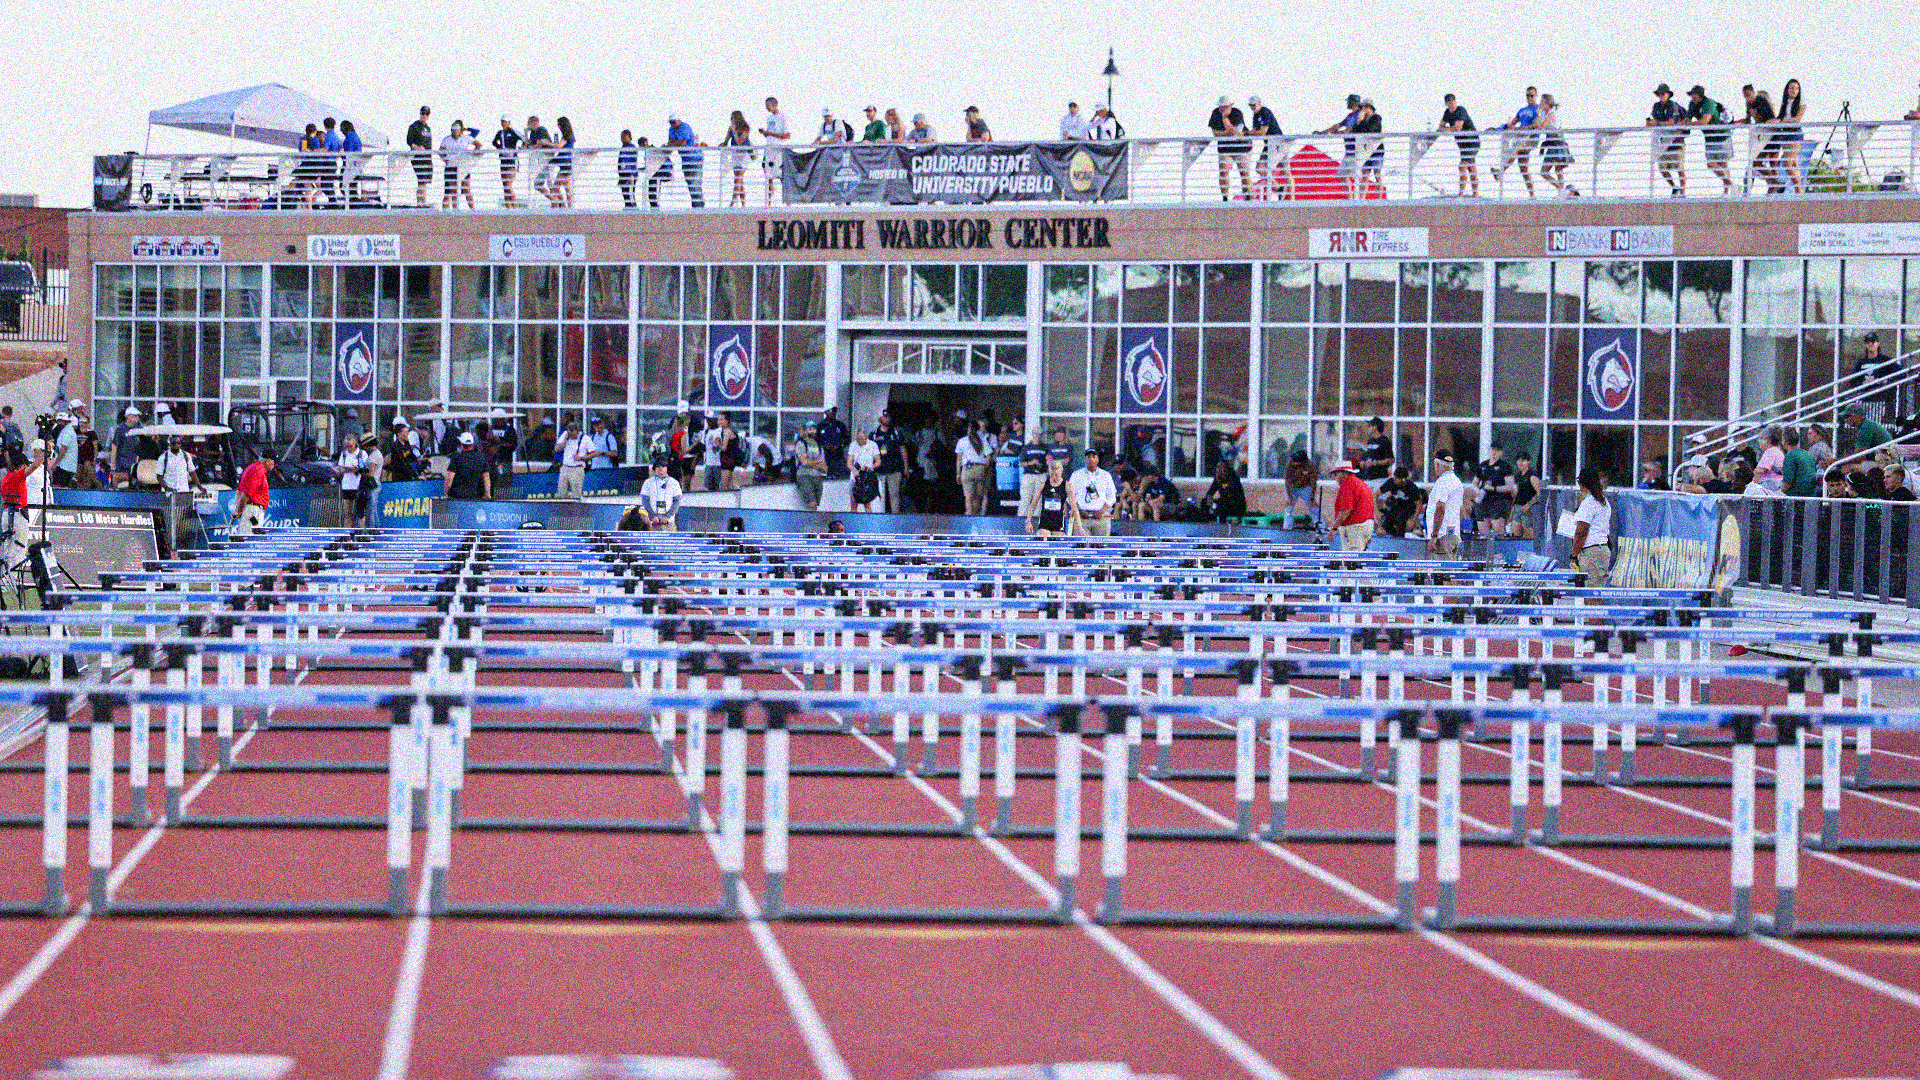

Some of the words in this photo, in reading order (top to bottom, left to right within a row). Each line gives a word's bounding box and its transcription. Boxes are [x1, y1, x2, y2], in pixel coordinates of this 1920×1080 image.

[912, 155, 986, 174] COLORADO
[990, 154, 1032, 173] STATE
[868, 169, 897, 179] HOSTED
[898, 168, 908, 179] BY
[912, 176, 998, 194] UNIVERSITY
[999, 175, 1053, 194] PUEBLO
[757, 220, 865, 250] LEOMITI
[876, 219, 993, 250] WARRIOR
[1004, 218, 1112, 249] CENTER
[1372, 230, 1390, 241] TIRE
[328, 238, 349, 247] United
[373, 238, 394, 247] United
[514, 237, 529, 248] CSU
[531, 237, 561, 248] PUEBLO
[1371, 242, 1409, 252] EXPRESS
[328, 248, 350, 256] Rentals
[373, 248, 396, 256] Rentals
[46, 512, 75, 524] Women
[76, 513, 94, 524] 100
[95, 513, 119, 525] Meter
[120, 514, 152, 526] Hurdles
